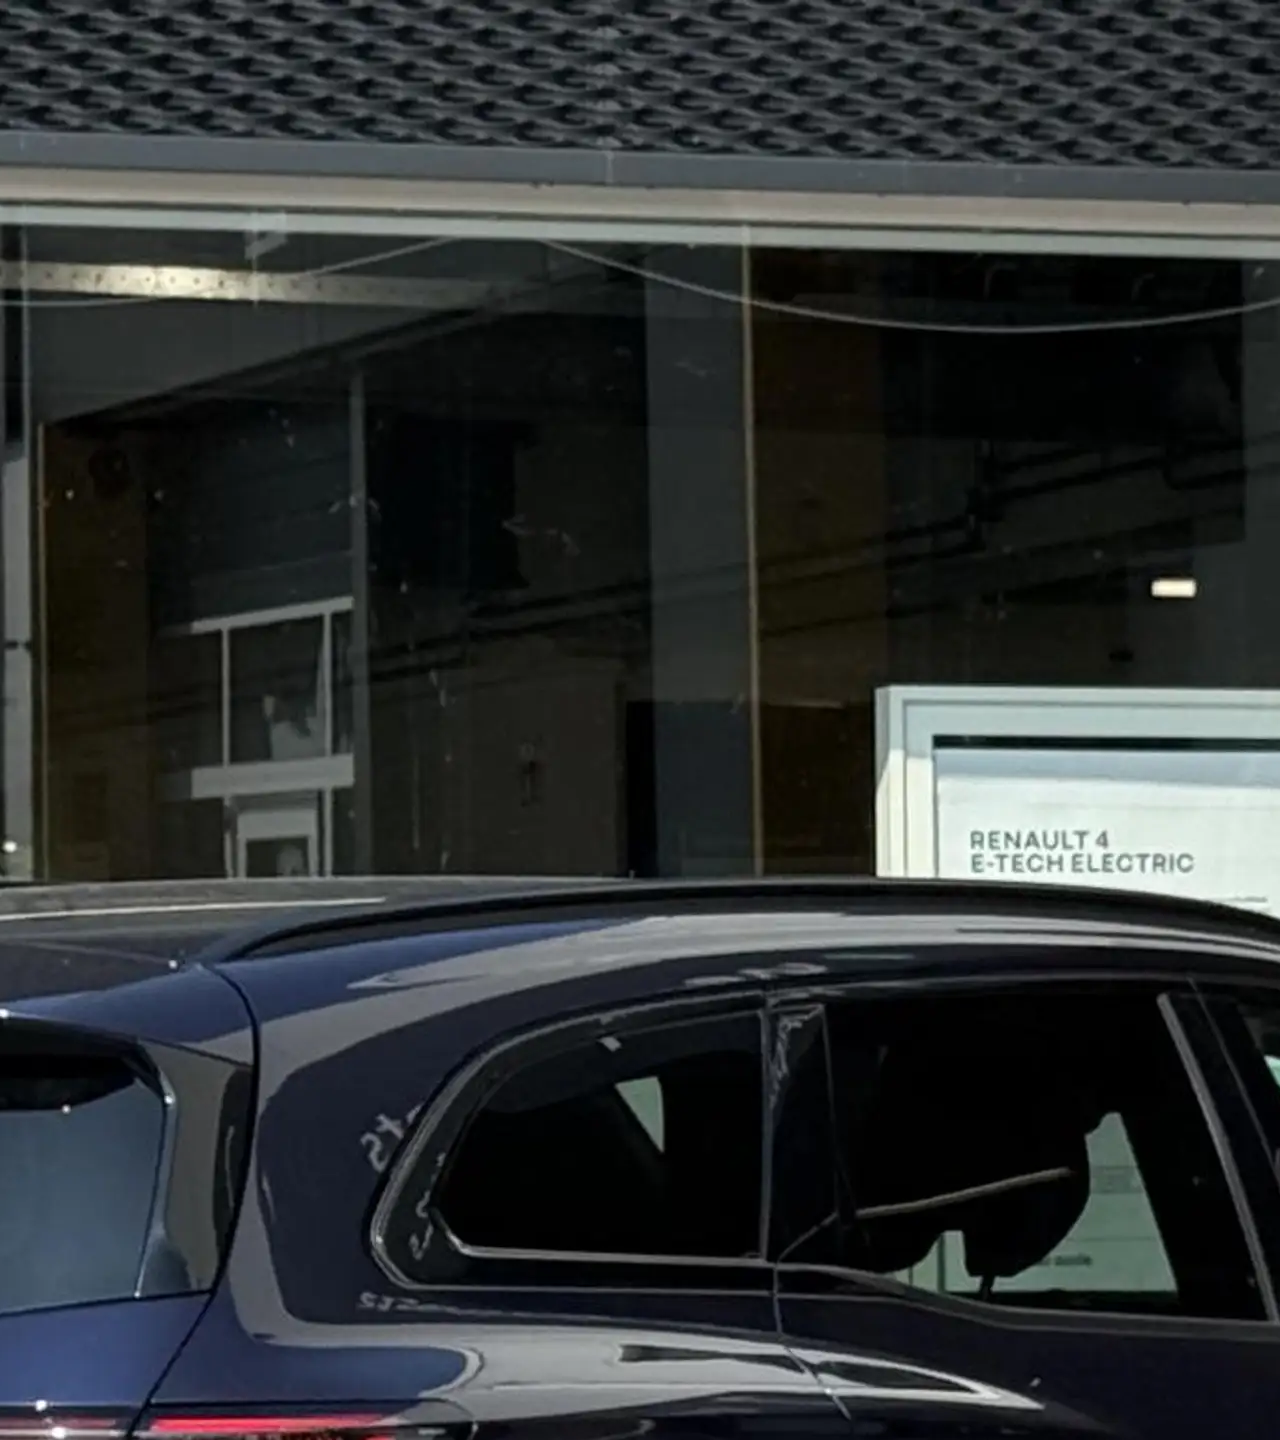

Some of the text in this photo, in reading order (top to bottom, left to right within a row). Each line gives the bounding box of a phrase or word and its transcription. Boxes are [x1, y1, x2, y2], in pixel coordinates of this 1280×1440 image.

[969, 829, 1110, 851] RENAULT 4
[971, 853, 1195, 874] E-TECH ELECTRIC
